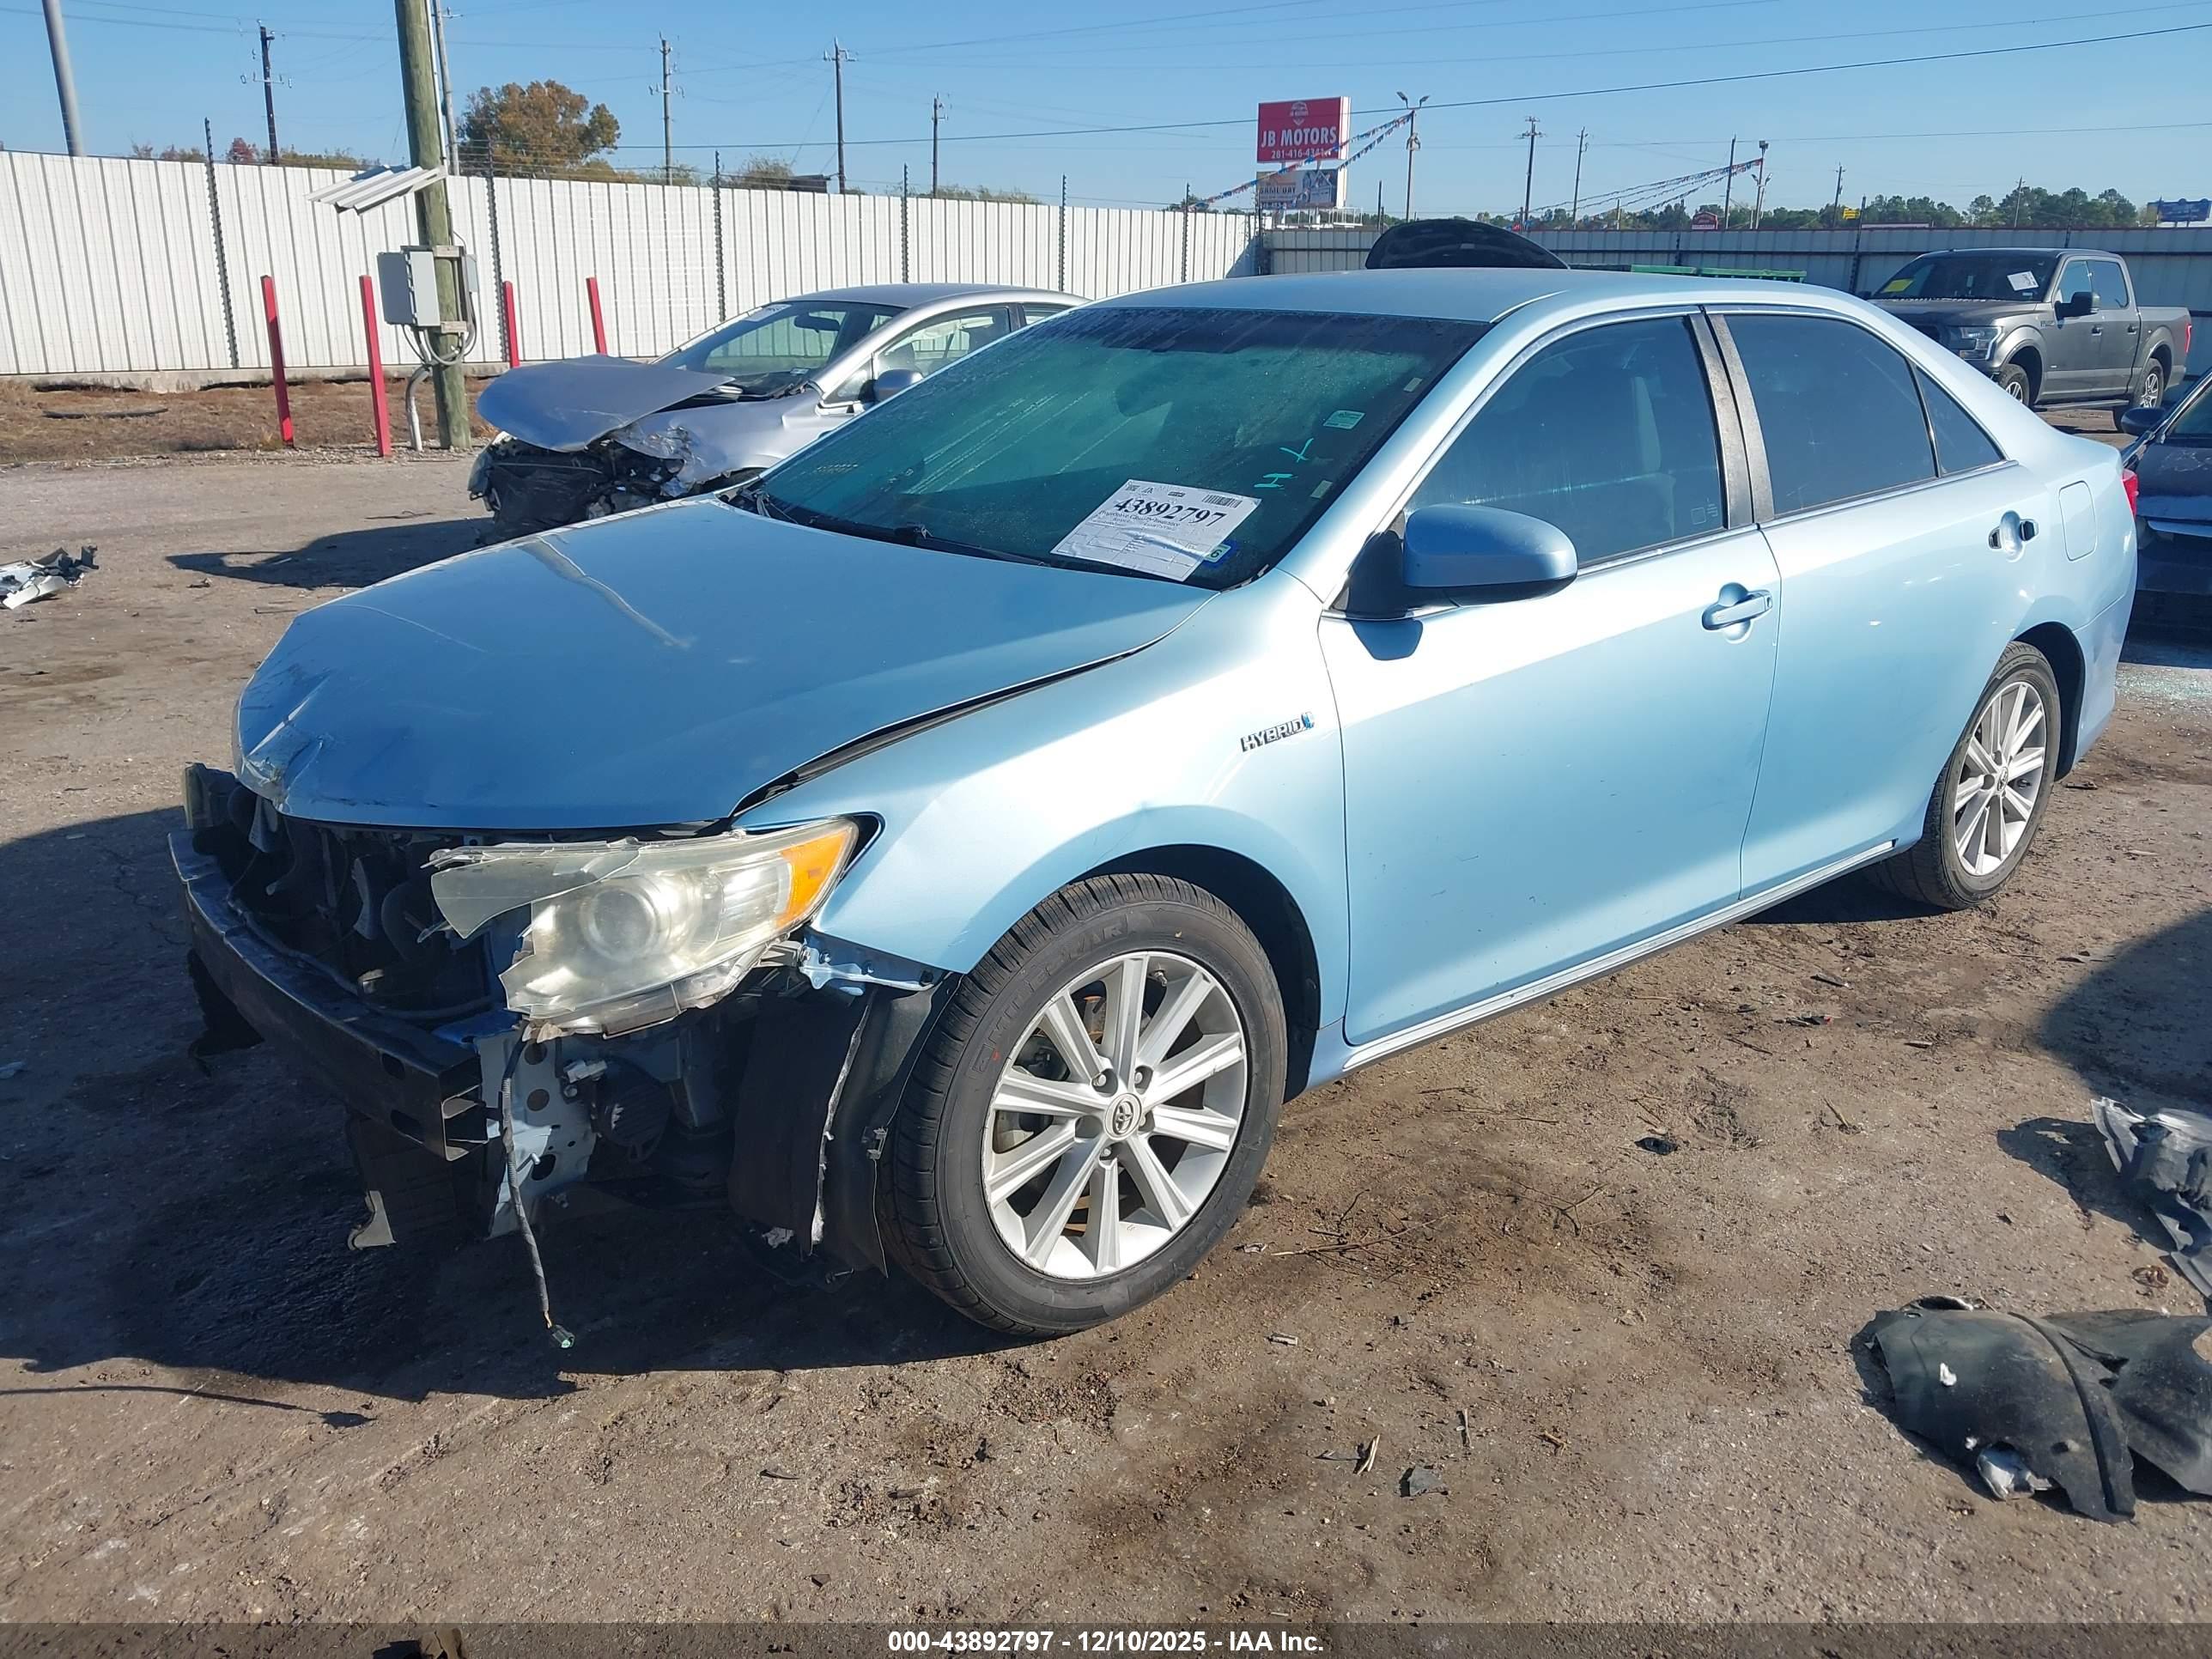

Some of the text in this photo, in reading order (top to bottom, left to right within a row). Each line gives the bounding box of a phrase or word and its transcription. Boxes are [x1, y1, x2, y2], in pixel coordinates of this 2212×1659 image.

[1261, 126, 1337, 148] JB MOTORS
[1114, 496, 1227, 527] 43892797
[1240, 719, 1303, 753] HYBRID
